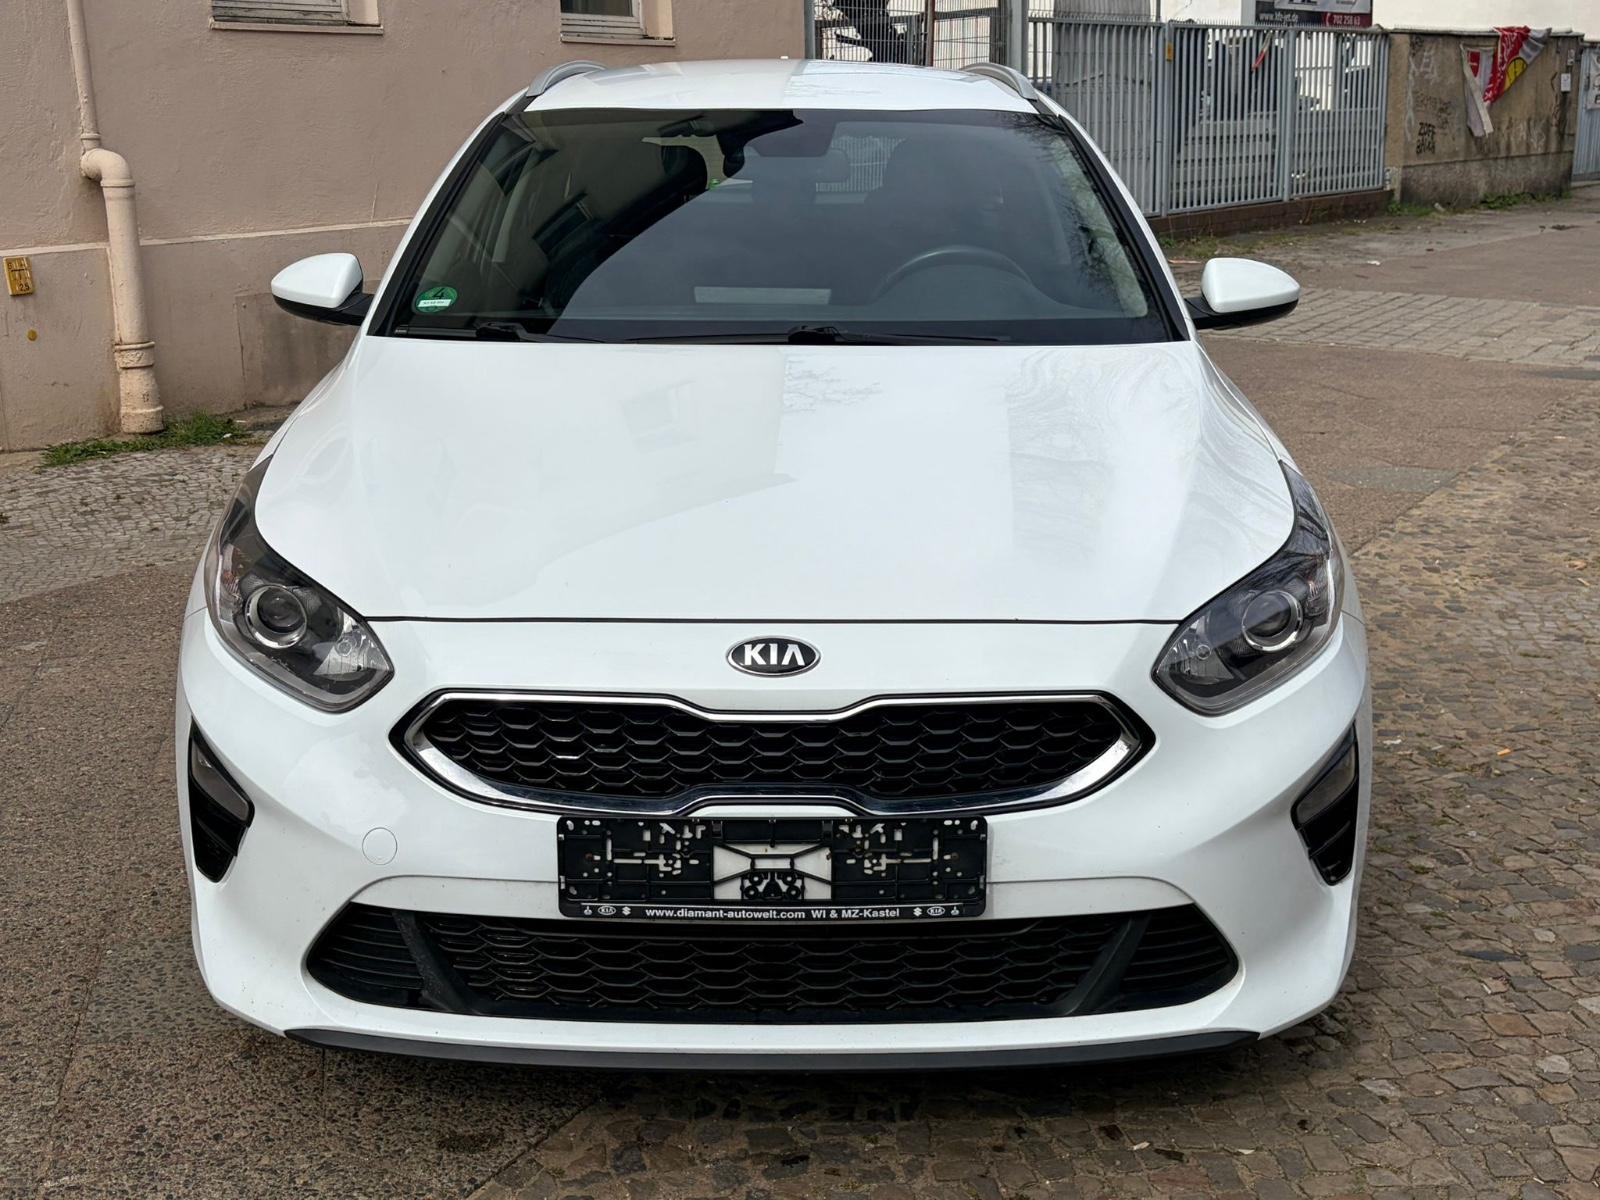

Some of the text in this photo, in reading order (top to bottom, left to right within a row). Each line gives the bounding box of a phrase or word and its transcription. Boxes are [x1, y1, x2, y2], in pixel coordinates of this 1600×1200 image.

[432, 287, 445, 300] 4
[743, 643, 806, 666] KIA
[645, 907, 900, 919] www.diamant-autowelt.com WI & MZ-Kastel
